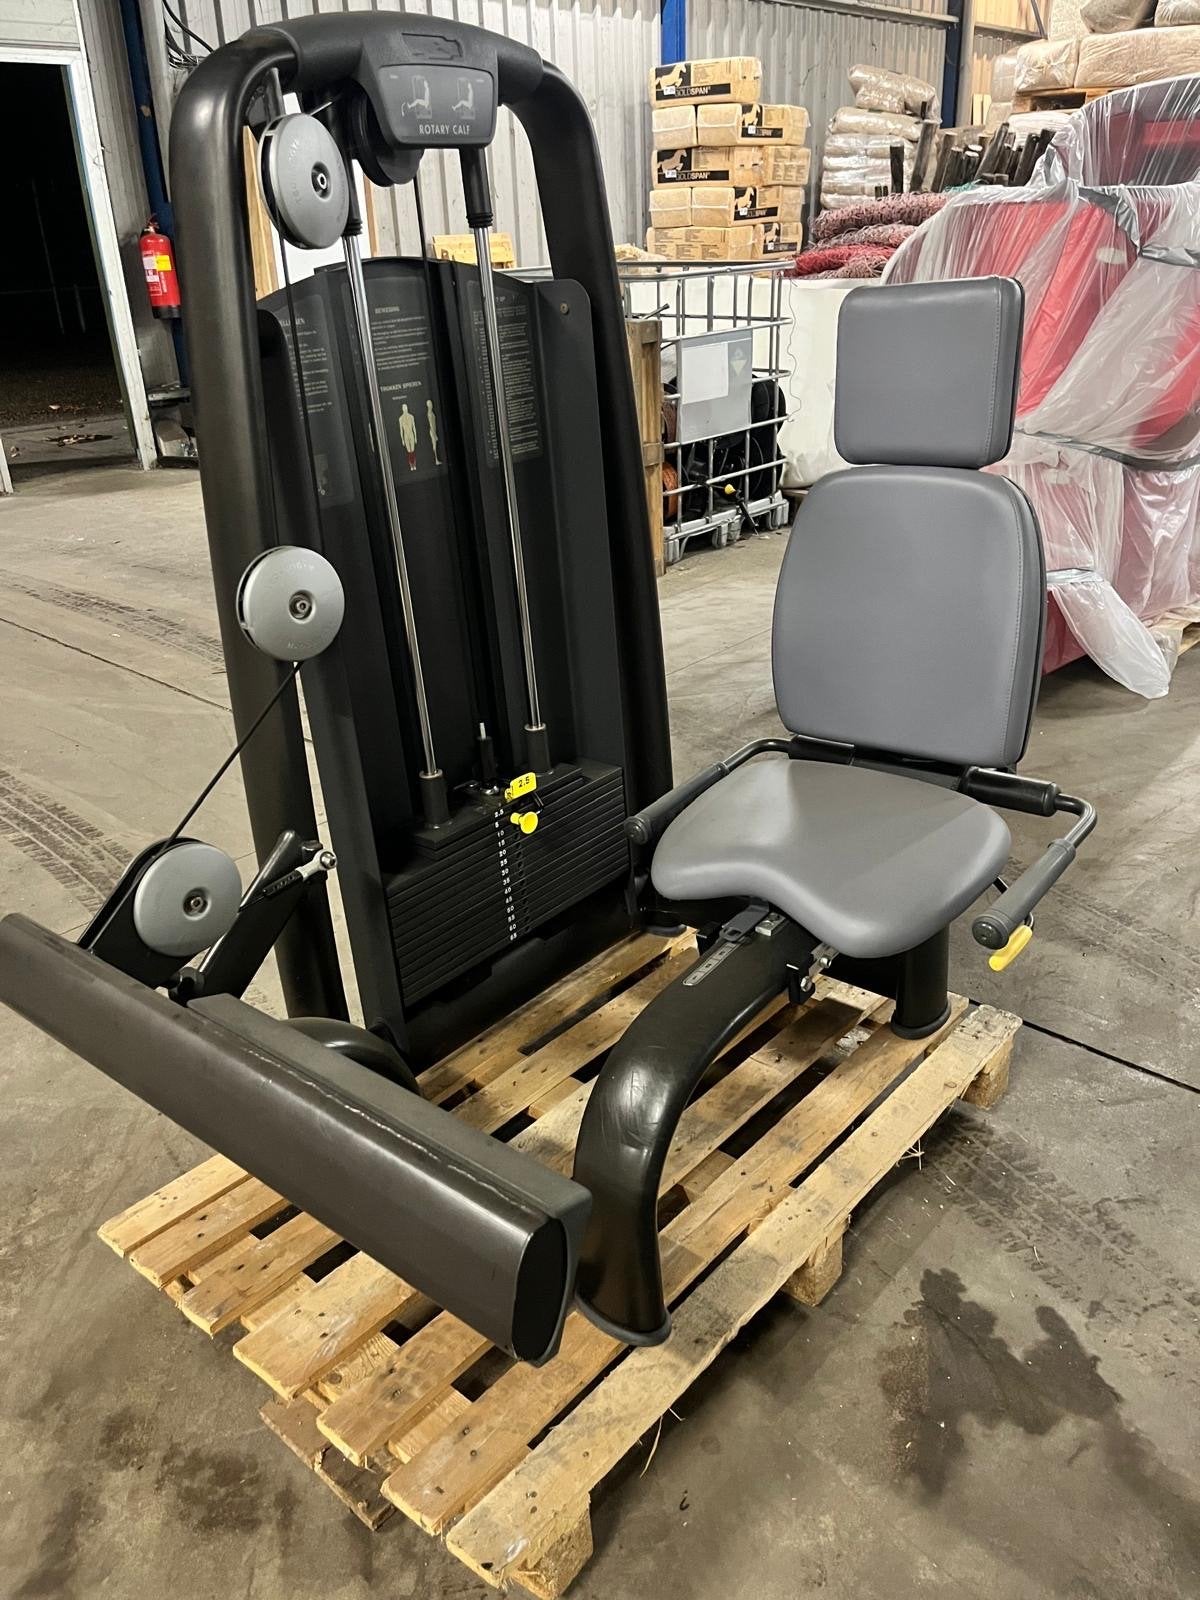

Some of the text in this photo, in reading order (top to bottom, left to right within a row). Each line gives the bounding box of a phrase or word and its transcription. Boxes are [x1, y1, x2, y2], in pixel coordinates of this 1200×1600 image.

[419, 124, 470, 135] ROTARY CALF
[518, 776, 530, 788] 2.5
[497, 829, 504, 837] 10
[499, 849, 506, 857] 20
[500, 858, 508, 867] 25
[501, 868, 509, 876] 30
